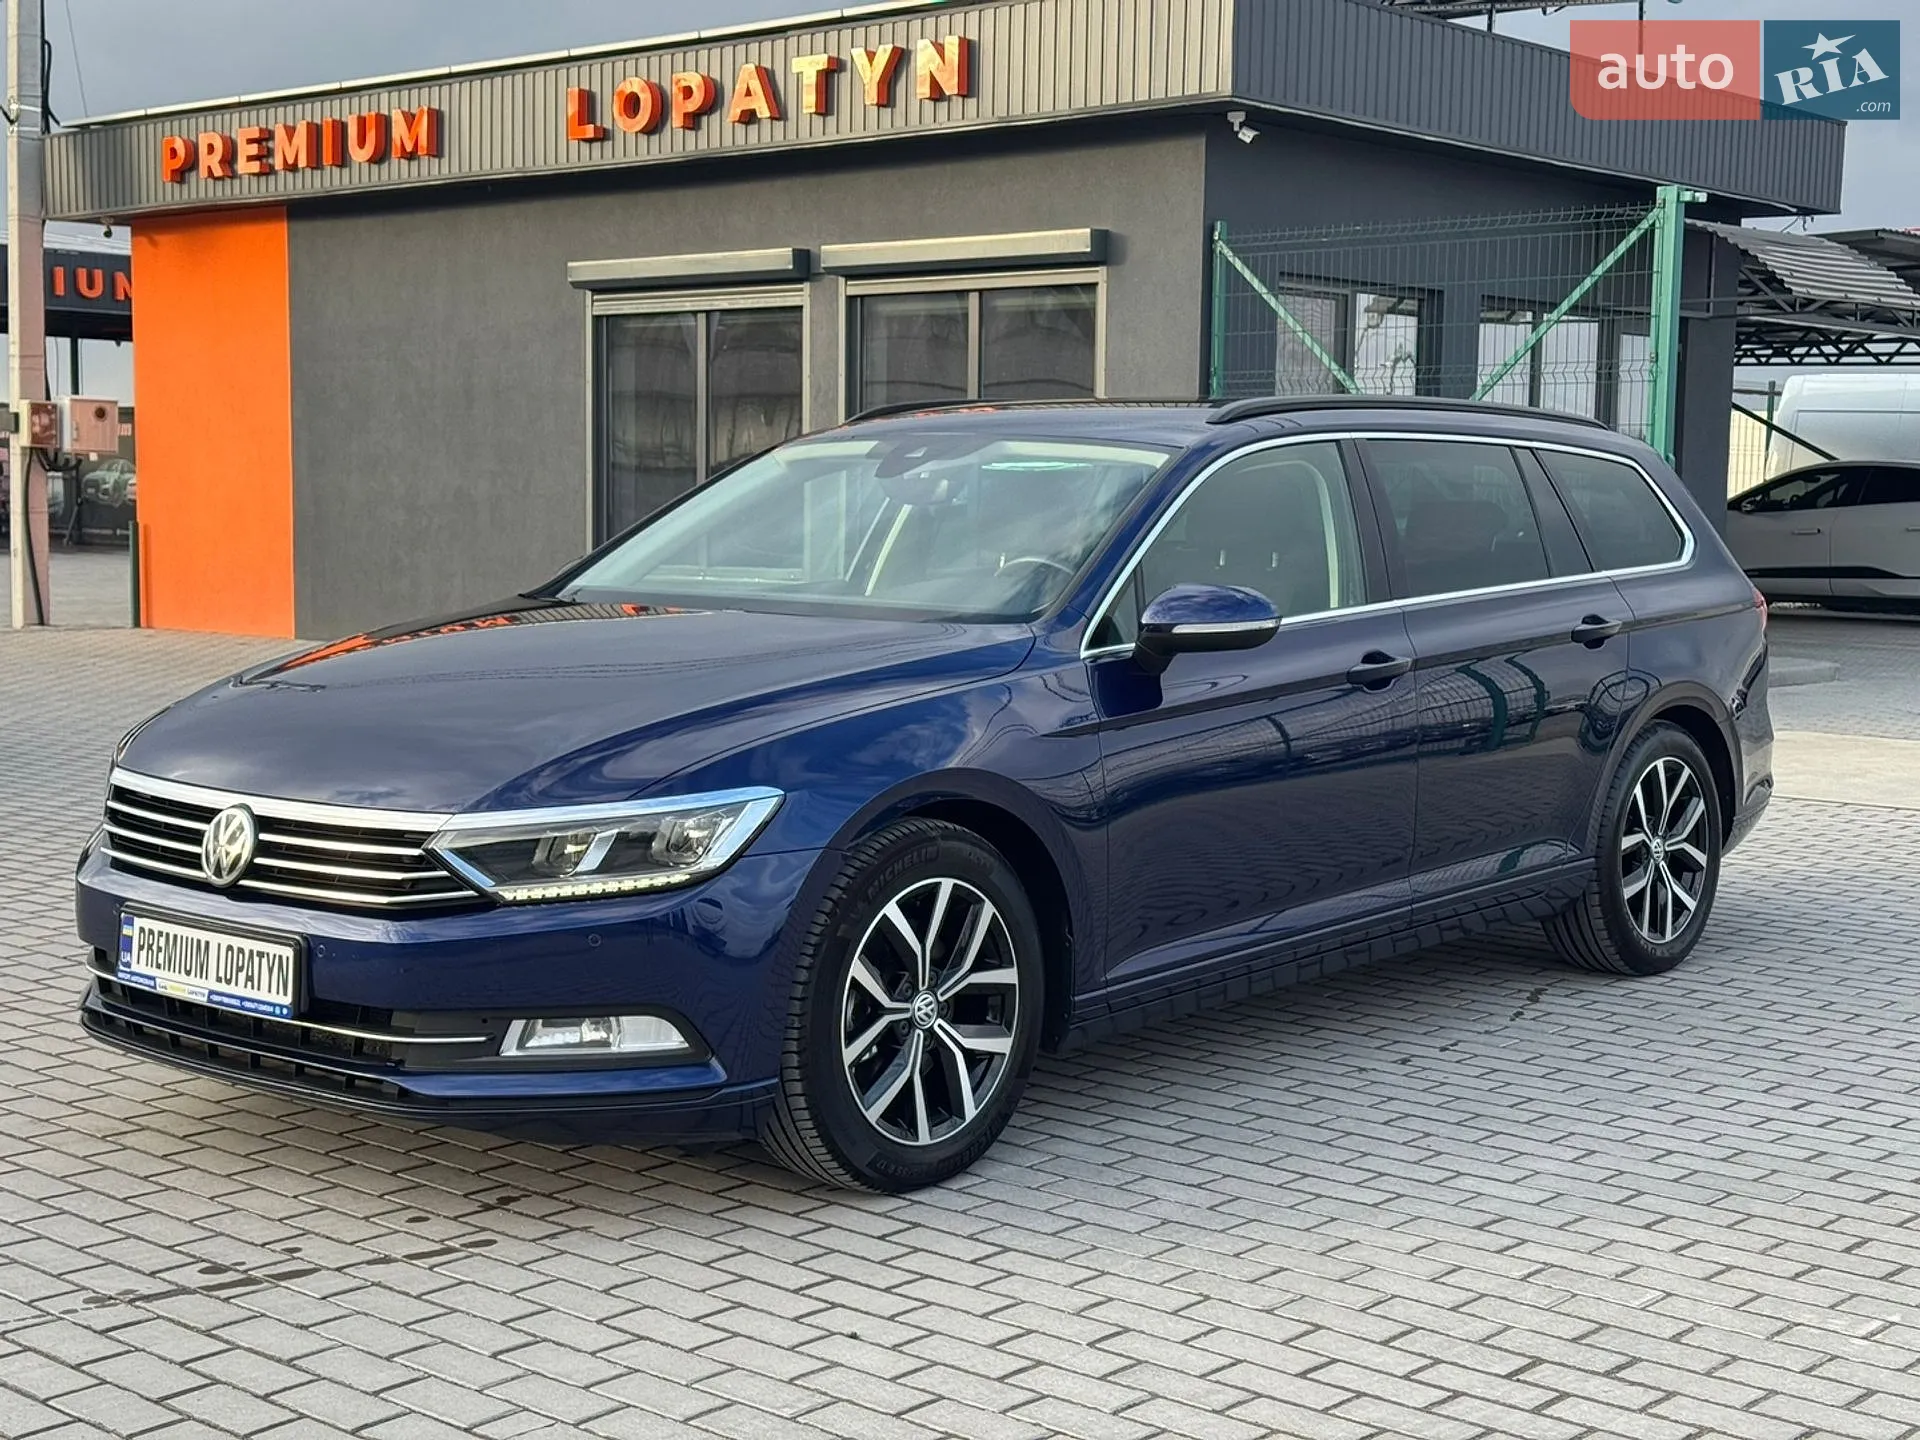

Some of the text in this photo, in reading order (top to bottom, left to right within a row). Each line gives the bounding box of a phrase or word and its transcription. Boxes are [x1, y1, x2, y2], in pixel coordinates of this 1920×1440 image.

[162, 35, 968, 183] PREMIUM LOPATYN
[136, 926, 289, 997] PREMIUM LOPATYN
